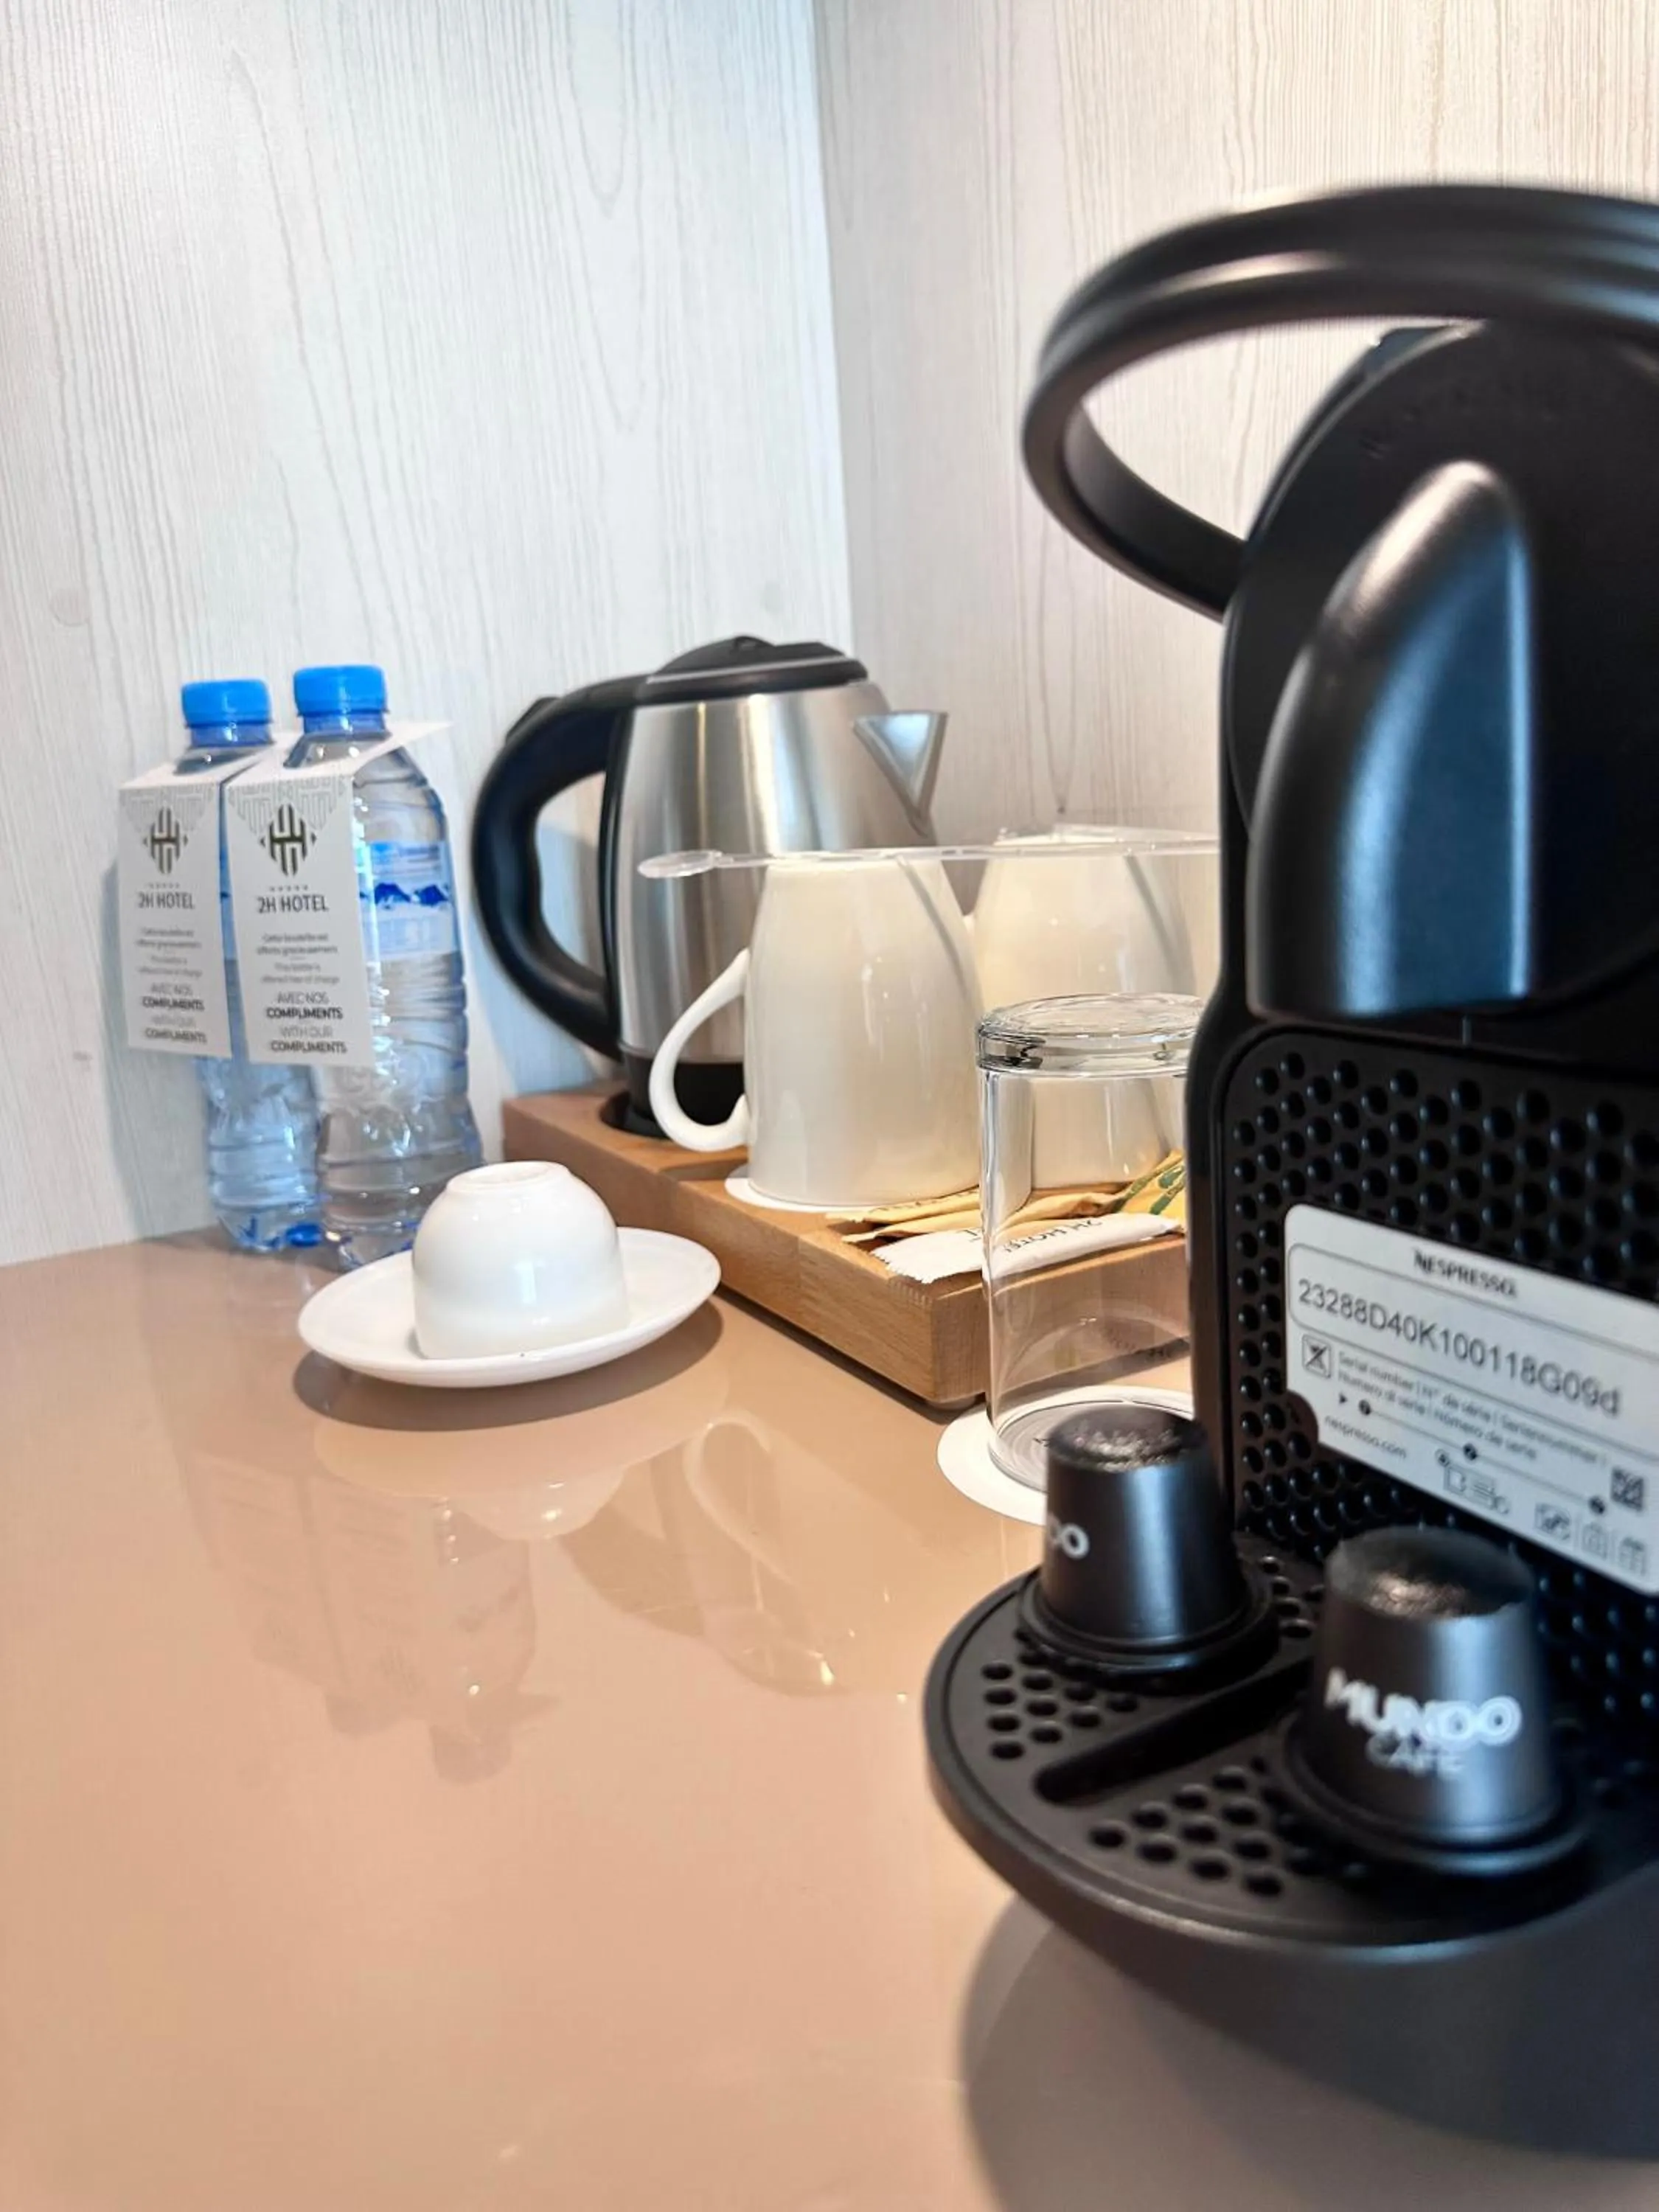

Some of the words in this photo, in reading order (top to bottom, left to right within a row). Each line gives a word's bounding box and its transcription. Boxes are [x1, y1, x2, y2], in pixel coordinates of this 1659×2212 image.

[138, 891, 153, 908] 2H
[156, 891, 195, 909] HOTEL
[257, 895, 276, 914] 2H
[281, 894, 330, 913] HOTEL
[142, 996, 205, 1012] COMPLIMENTS
[278, 992, 305, 1004] AVEC
[306, 991, 329, 1004] NOS
[266, 1006, 343, 1020] COMPLIMENTS
[271, 1040, 347, 1054] COMPLIMENTS
